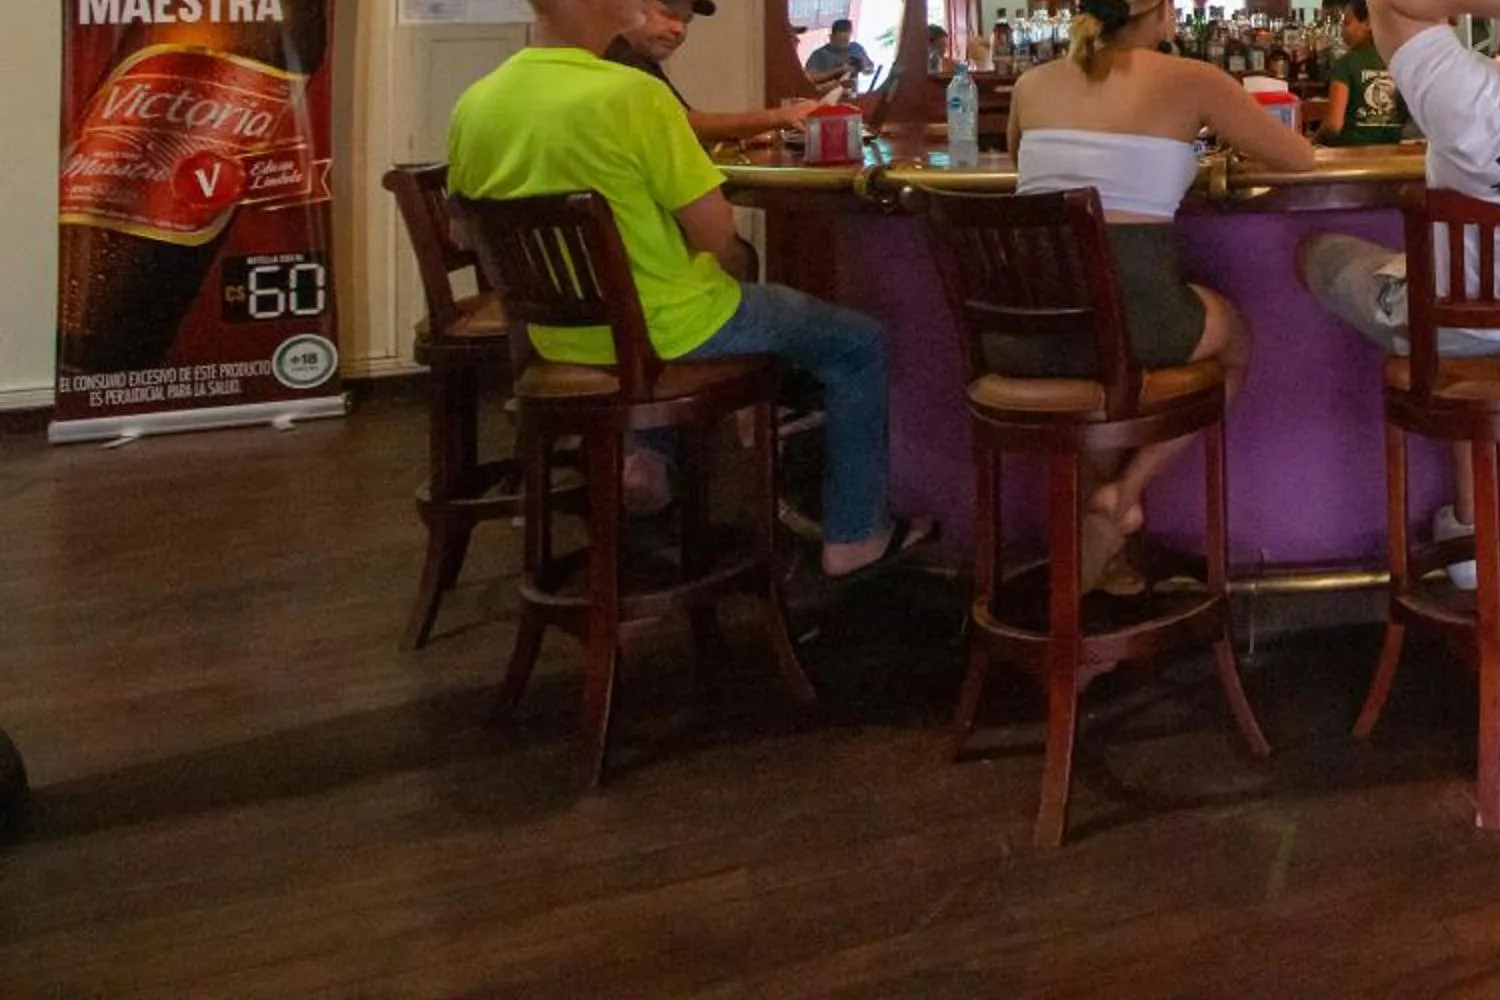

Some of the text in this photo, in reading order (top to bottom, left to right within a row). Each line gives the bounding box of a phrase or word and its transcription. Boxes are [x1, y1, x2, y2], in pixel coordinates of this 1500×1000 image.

[101, 82, 273, 137] Victoria
[195, 162, 221, 198] V
[249, 263, 326, 319] 60
[74, 372, 127, 392] CONSUMO
[128, 366, 177, 387] EXCESIVO
[179, 366, 193, 382] DE
[194, 363, 218, 381] ESTE
[219, 359, 272, 378] PRODUCTO
[89, 390, 104, 407] ES
[167, 382, 193, 399] PARA
[194, 379, 207, 397] LA
